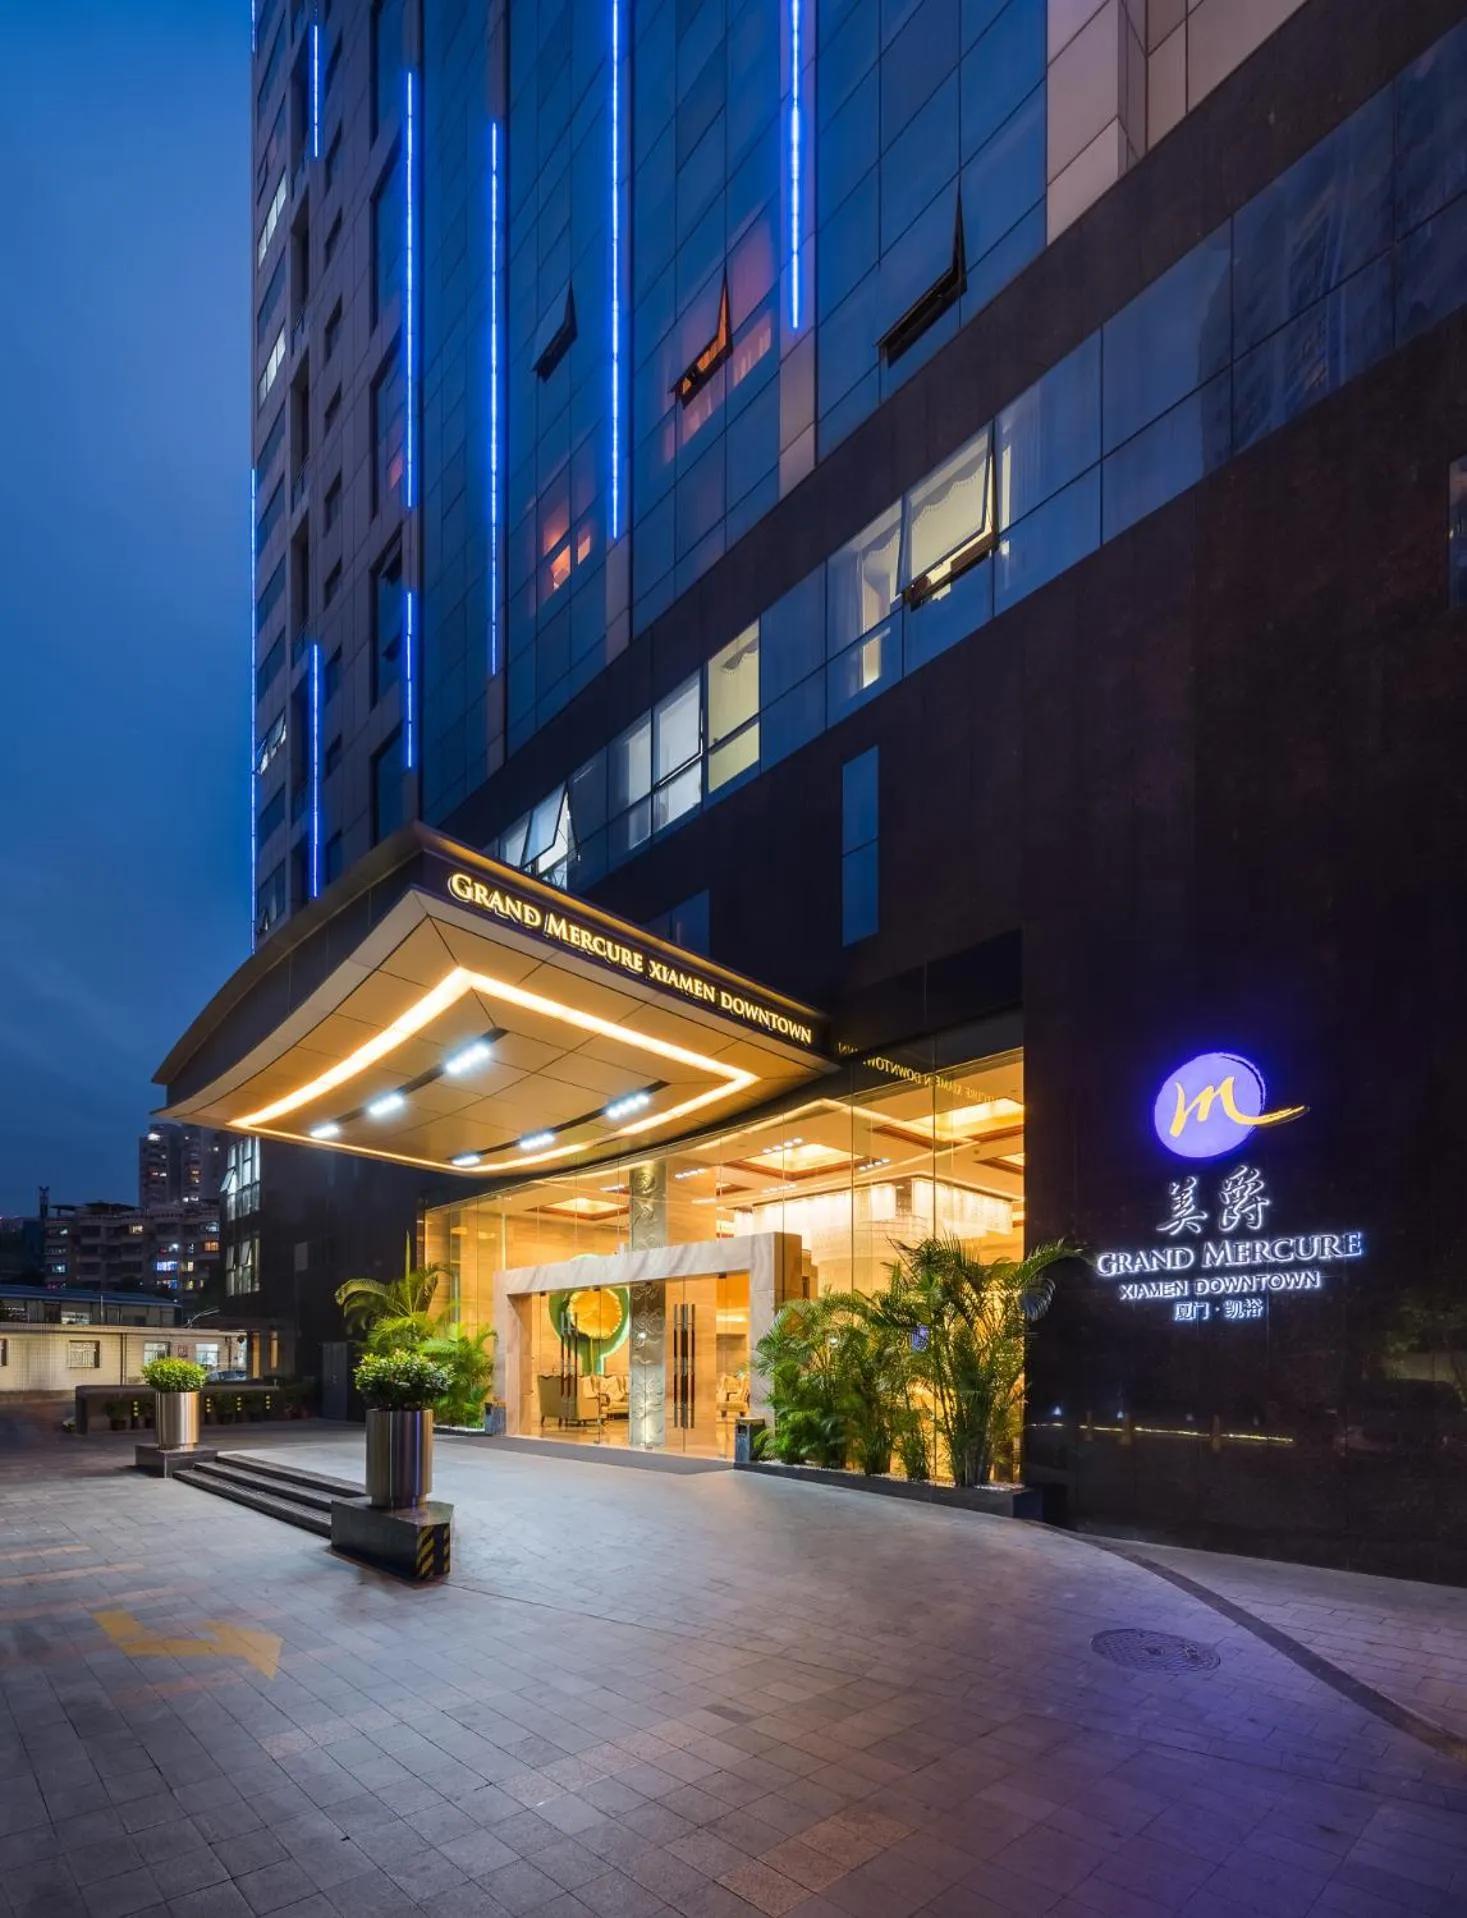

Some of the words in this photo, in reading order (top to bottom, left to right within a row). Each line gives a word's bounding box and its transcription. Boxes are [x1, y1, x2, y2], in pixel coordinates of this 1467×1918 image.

[447, 872, 542, 929] GRAND
[544, 911, 643, 974] MERCURE
[649, 959, 716, 1003] XIAMEN
[720, 991, 813, 1046] DOWNTOWN
[1156, 1164, 1271, 1236] 美爵
[1096, 1246, 1195, 1277] GRAND
[1201, 1231, 1364, 1268] MERCURE
[1119, 1279, 1188, 1301] XIAMEN
[1195, 1271, 1322, 1296] DOWNTOWN
